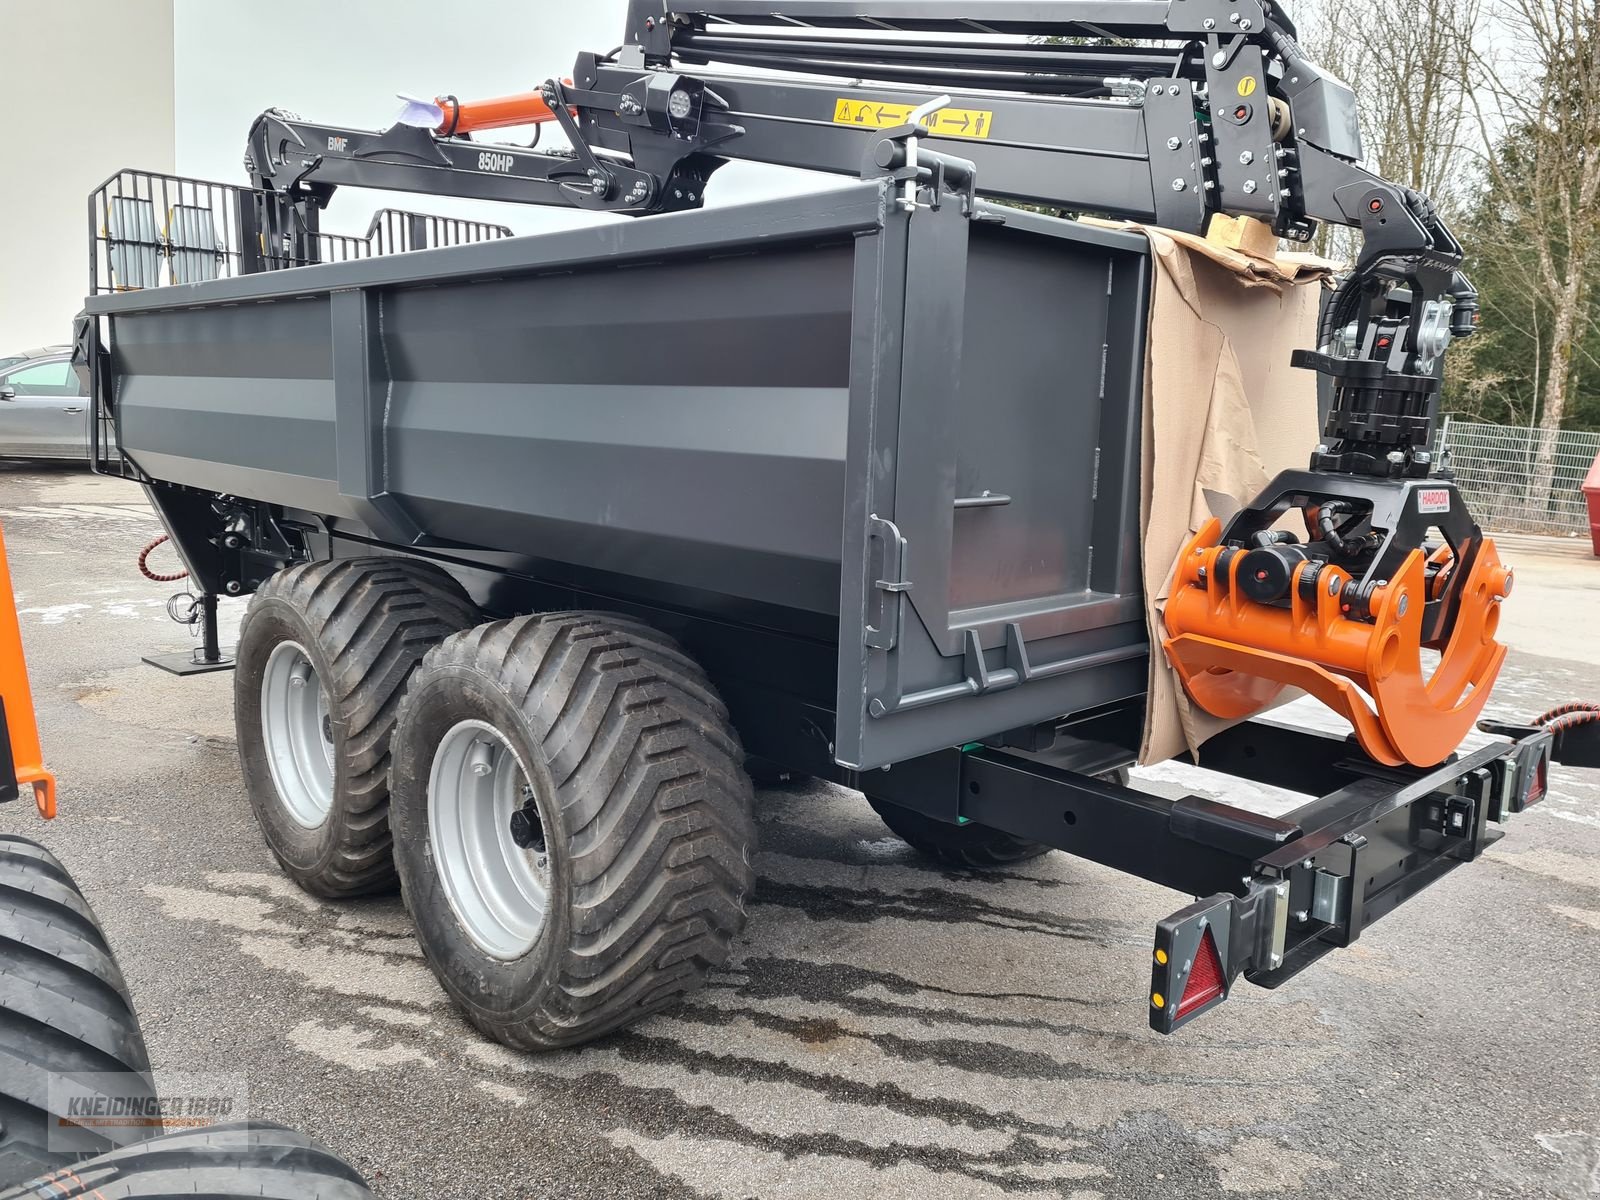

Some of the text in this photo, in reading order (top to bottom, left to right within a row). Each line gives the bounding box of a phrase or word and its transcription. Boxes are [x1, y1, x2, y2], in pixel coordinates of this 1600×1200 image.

[327, 136, 348, 152] BMF
[478, 152, 514, 172] 850HP
[1422, 491, 1448, 504] HARDOX
